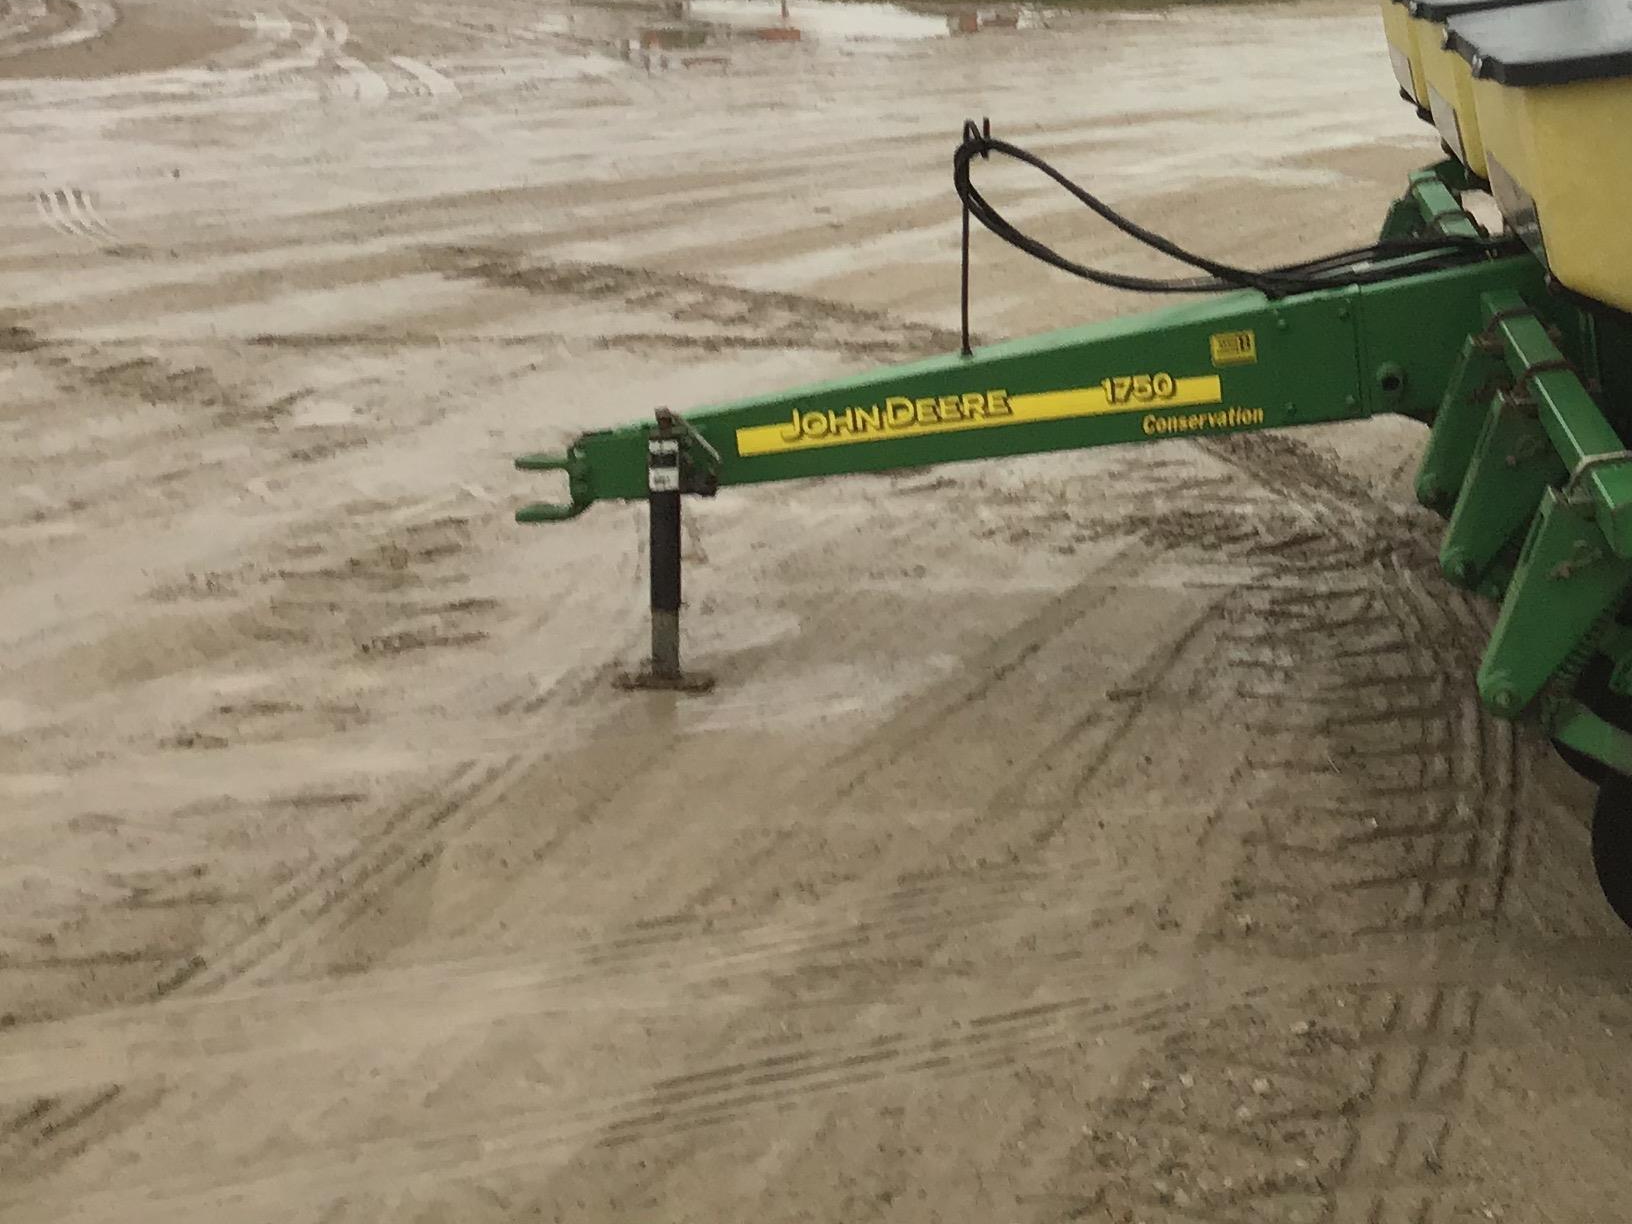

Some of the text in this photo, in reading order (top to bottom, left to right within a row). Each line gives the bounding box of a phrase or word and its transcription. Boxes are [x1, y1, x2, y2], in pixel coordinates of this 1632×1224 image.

[780, 372, 1176, 444] JOHN DEERE 1750
[1142, 405, 1264, 436] Conservation
